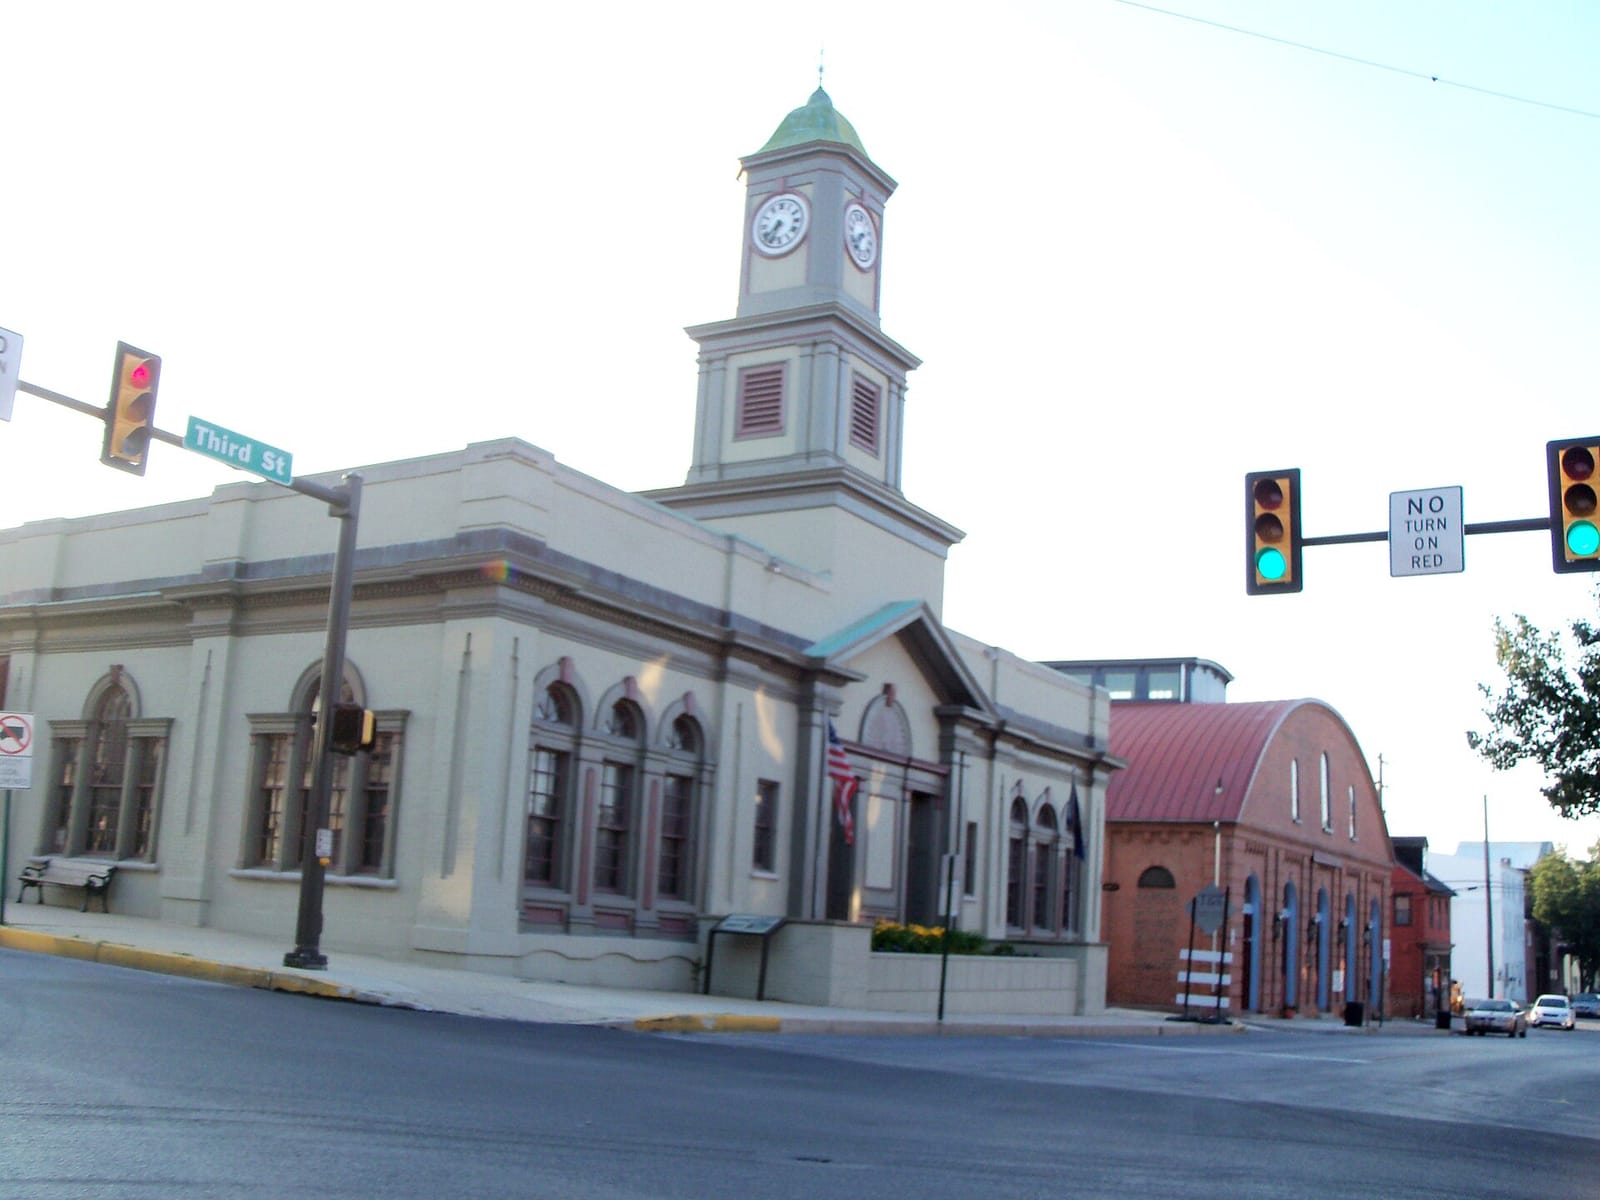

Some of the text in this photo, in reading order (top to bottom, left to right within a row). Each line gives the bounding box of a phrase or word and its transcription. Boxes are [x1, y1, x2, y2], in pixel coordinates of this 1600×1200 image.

[194, 423, 286, 476] Third St
[1407, 495, 1444, 515] NO
[1405, 517, 1447, 533] TURN
[1414, 536, 1438, 551] ON
[1411, 553, 1443, 569] RED
